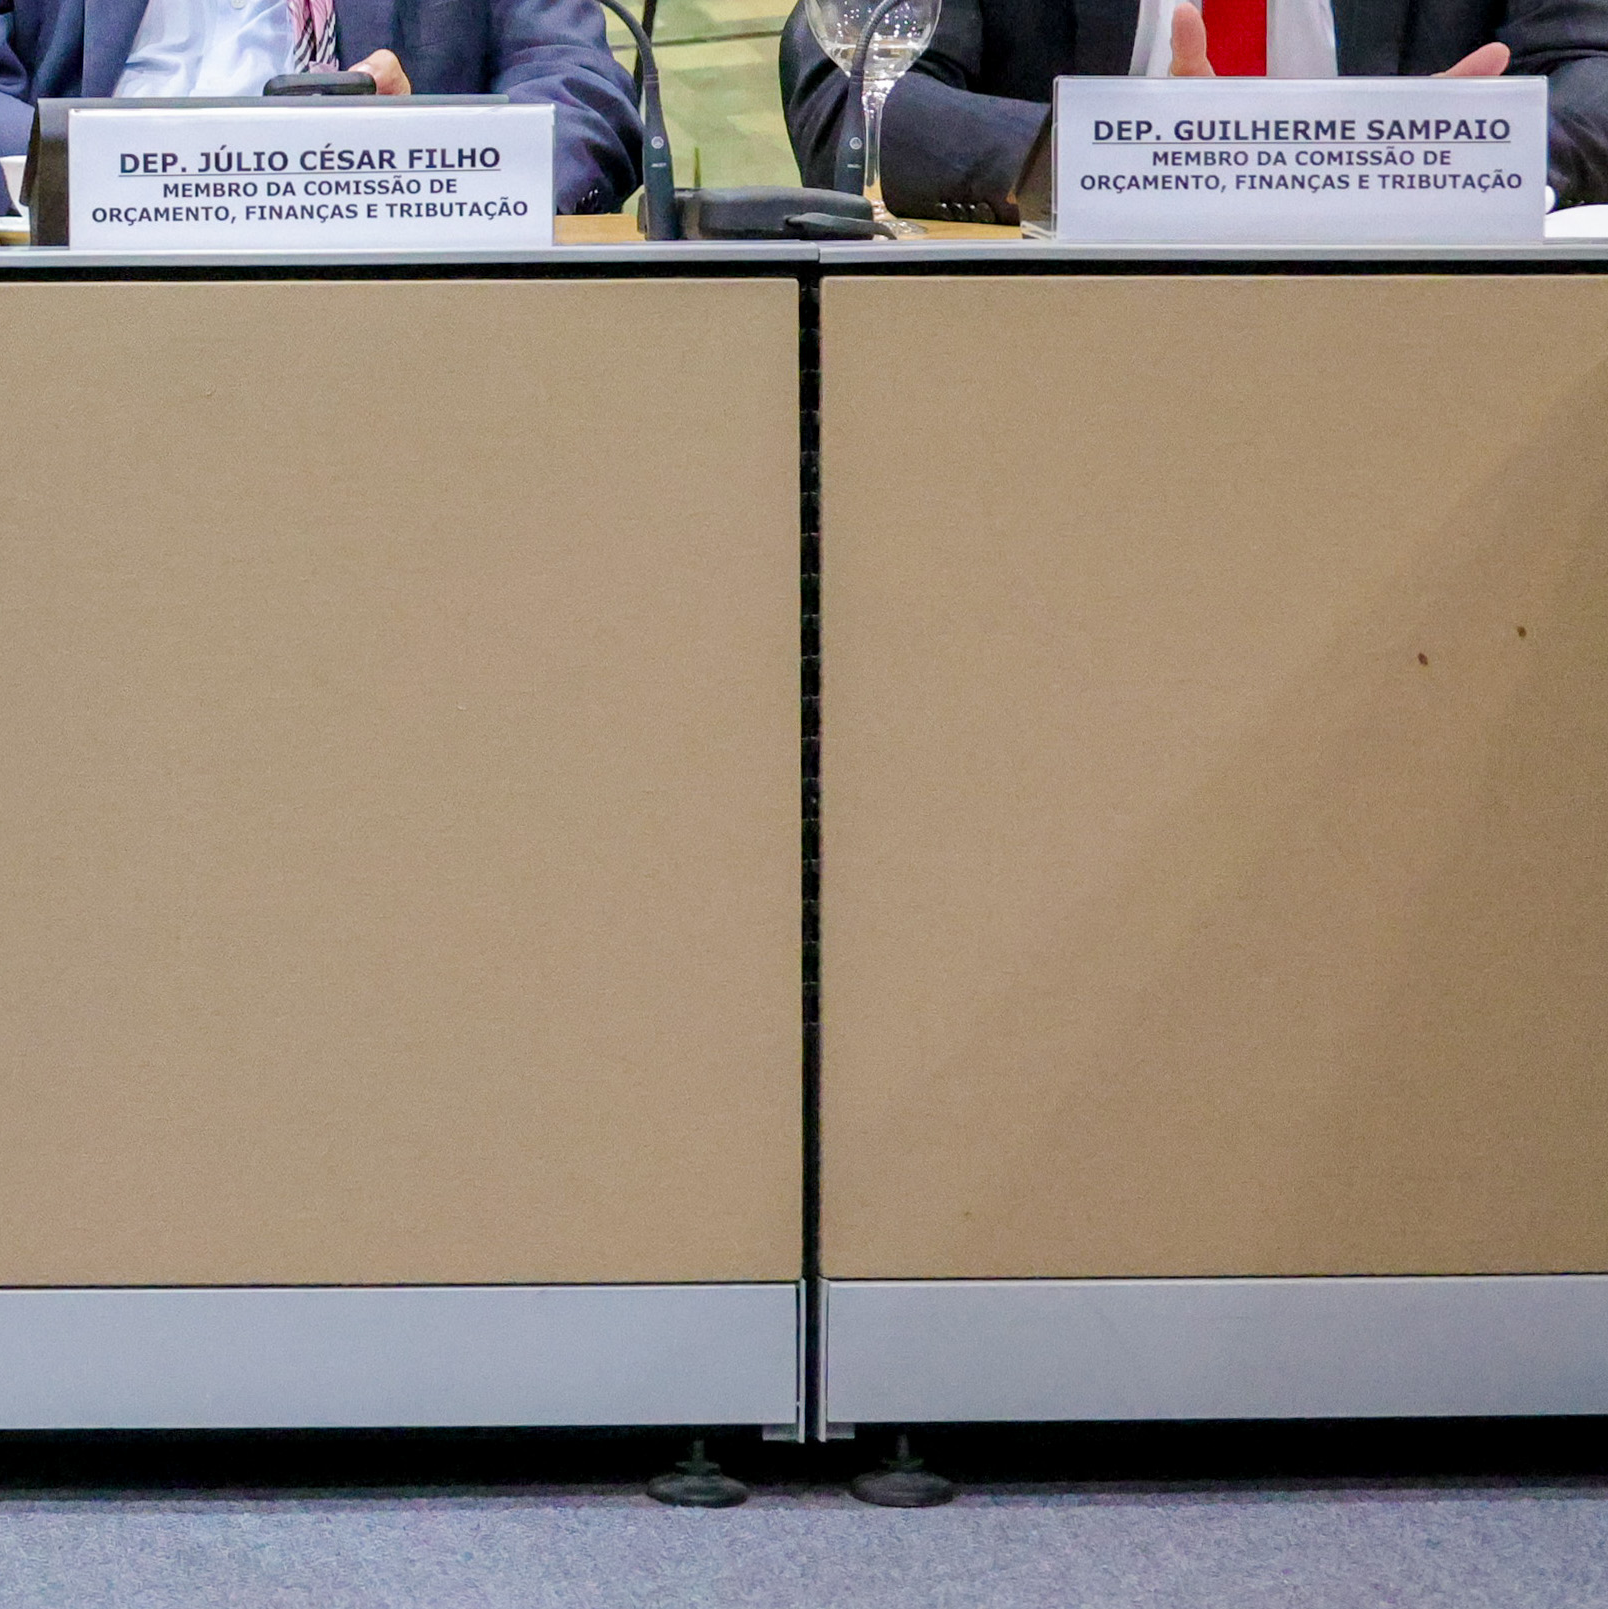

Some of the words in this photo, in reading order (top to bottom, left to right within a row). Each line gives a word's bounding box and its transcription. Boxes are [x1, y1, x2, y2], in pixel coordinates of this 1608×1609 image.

[1094, 120, 1161, 141] DEP.
[1173, 119, 1356, 141] GUILHERME
[1366, 118, 1511, 141] SAMPAIO
[120, 152, 187, 174] DEP.
[197, 144, 289, 173] JÚLIO
[299, 142, 397, 172] CÉSAR
[408, 146, 501, 170] FILHO
[1152, 150, 1249, 167] MEMBRO
[1257, 150, 1287, 166] DA
[1295, 146, 1415, 166] COMISSÃO
[1423, 150, 1451, 166] DE
[163, 181, 258, 199] MEMBRO
[266, 181, 297, 197] DA
[303, 175, 422, 197] COMISSÃO
[429, 178, 457, 194] DE
[1080, 174, 1226, 194] ORÇAMENTO,
[1235, 174, 1350, 194] FINANÇAS
[1358, 174, 1370, 190] E
[1377, 169, 1522, 193] TRIBUTAÇÃO
[91, 205, 236, 227] ORÇAMENTO,
[245, 203, 359, 224] FINANÇAS
[366, 203, 378, 219] E
[385, 196, 528, 221] TRIBUTAÇÃO
